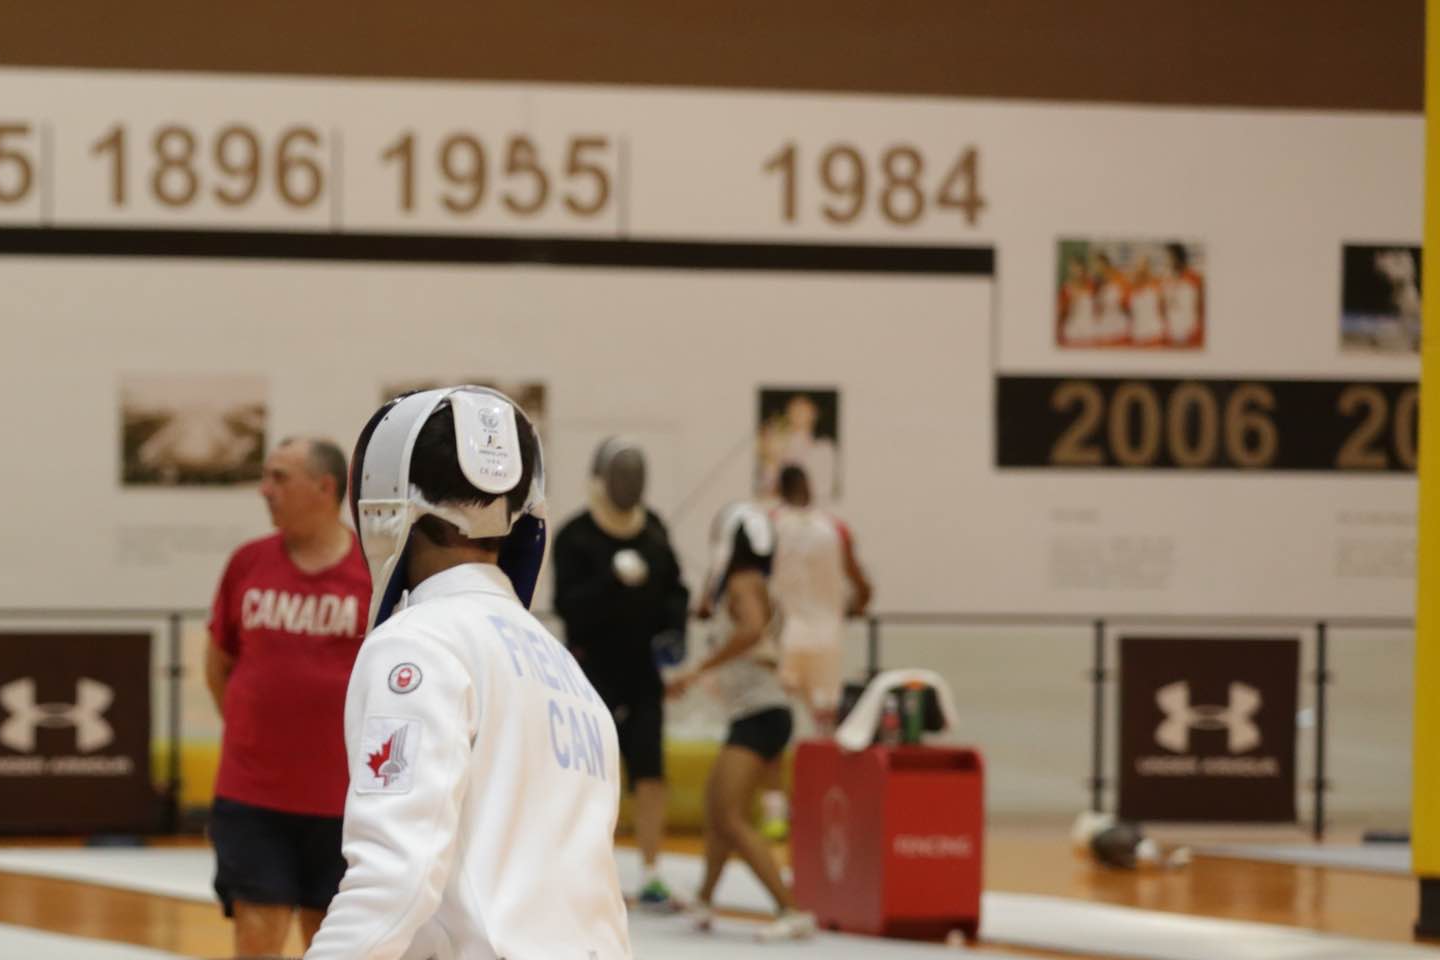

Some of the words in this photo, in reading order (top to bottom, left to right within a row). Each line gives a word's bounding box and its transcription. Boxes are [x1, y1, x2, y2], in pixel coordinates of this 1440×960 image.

[87, 123, 325, 210] 1896
[379, 130, 612, 217] 1955
[762, 140, 987, 228] 1984
[1049, 379, 1278, 470] 2006
[242, 587, 358, 637] CANADA
[547, 699, 606, 782] CAN
